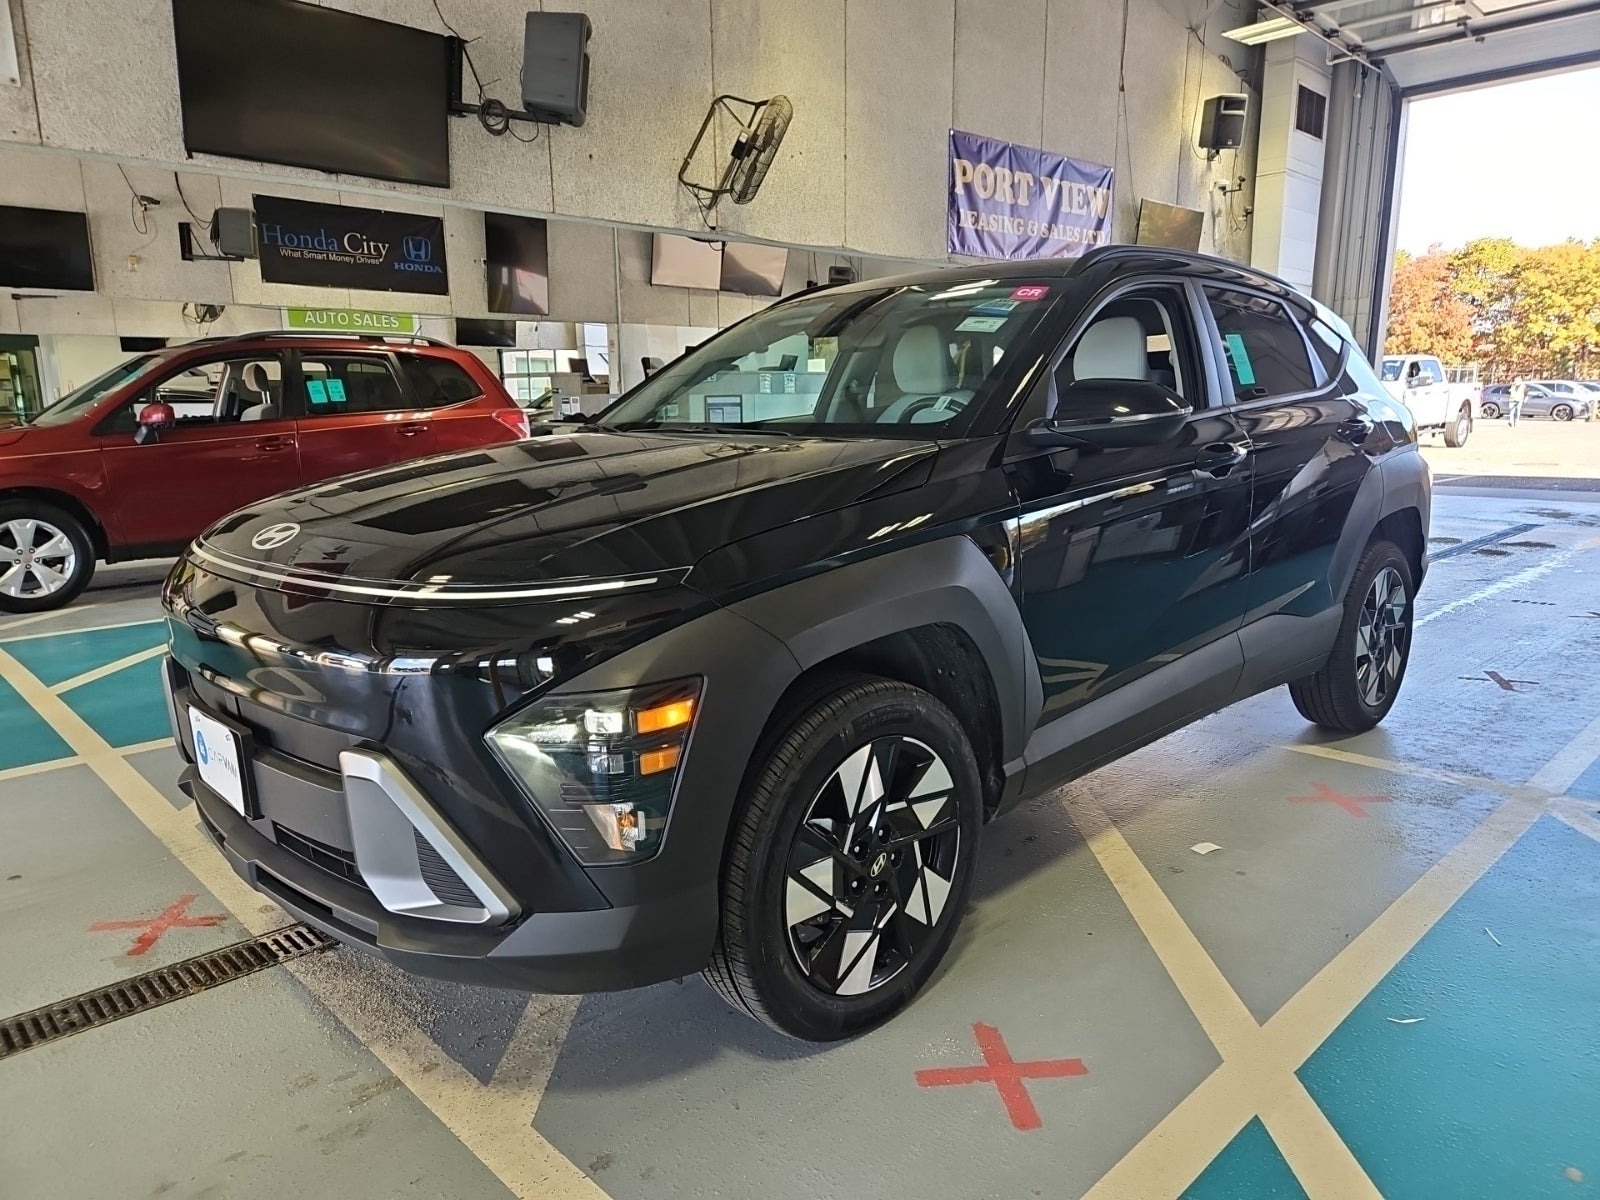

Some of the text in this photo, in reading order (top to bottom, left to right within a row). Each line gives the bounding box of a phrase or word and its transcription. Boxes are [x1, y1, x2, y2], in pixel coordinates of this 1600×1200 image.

[953, 158, 1111, 220] PORT VIEW
[959, 208, 1106, 246] LEASING & SALES LTD
[262, 223, 390, 262] Honda City
[280, 248, 380, 266] What Smart Money Drives
[393, 261, 443, 274] HONDA
[1016, 288, 1042, 297] CR
[304, 310, 400, 329] AUTO SALES
